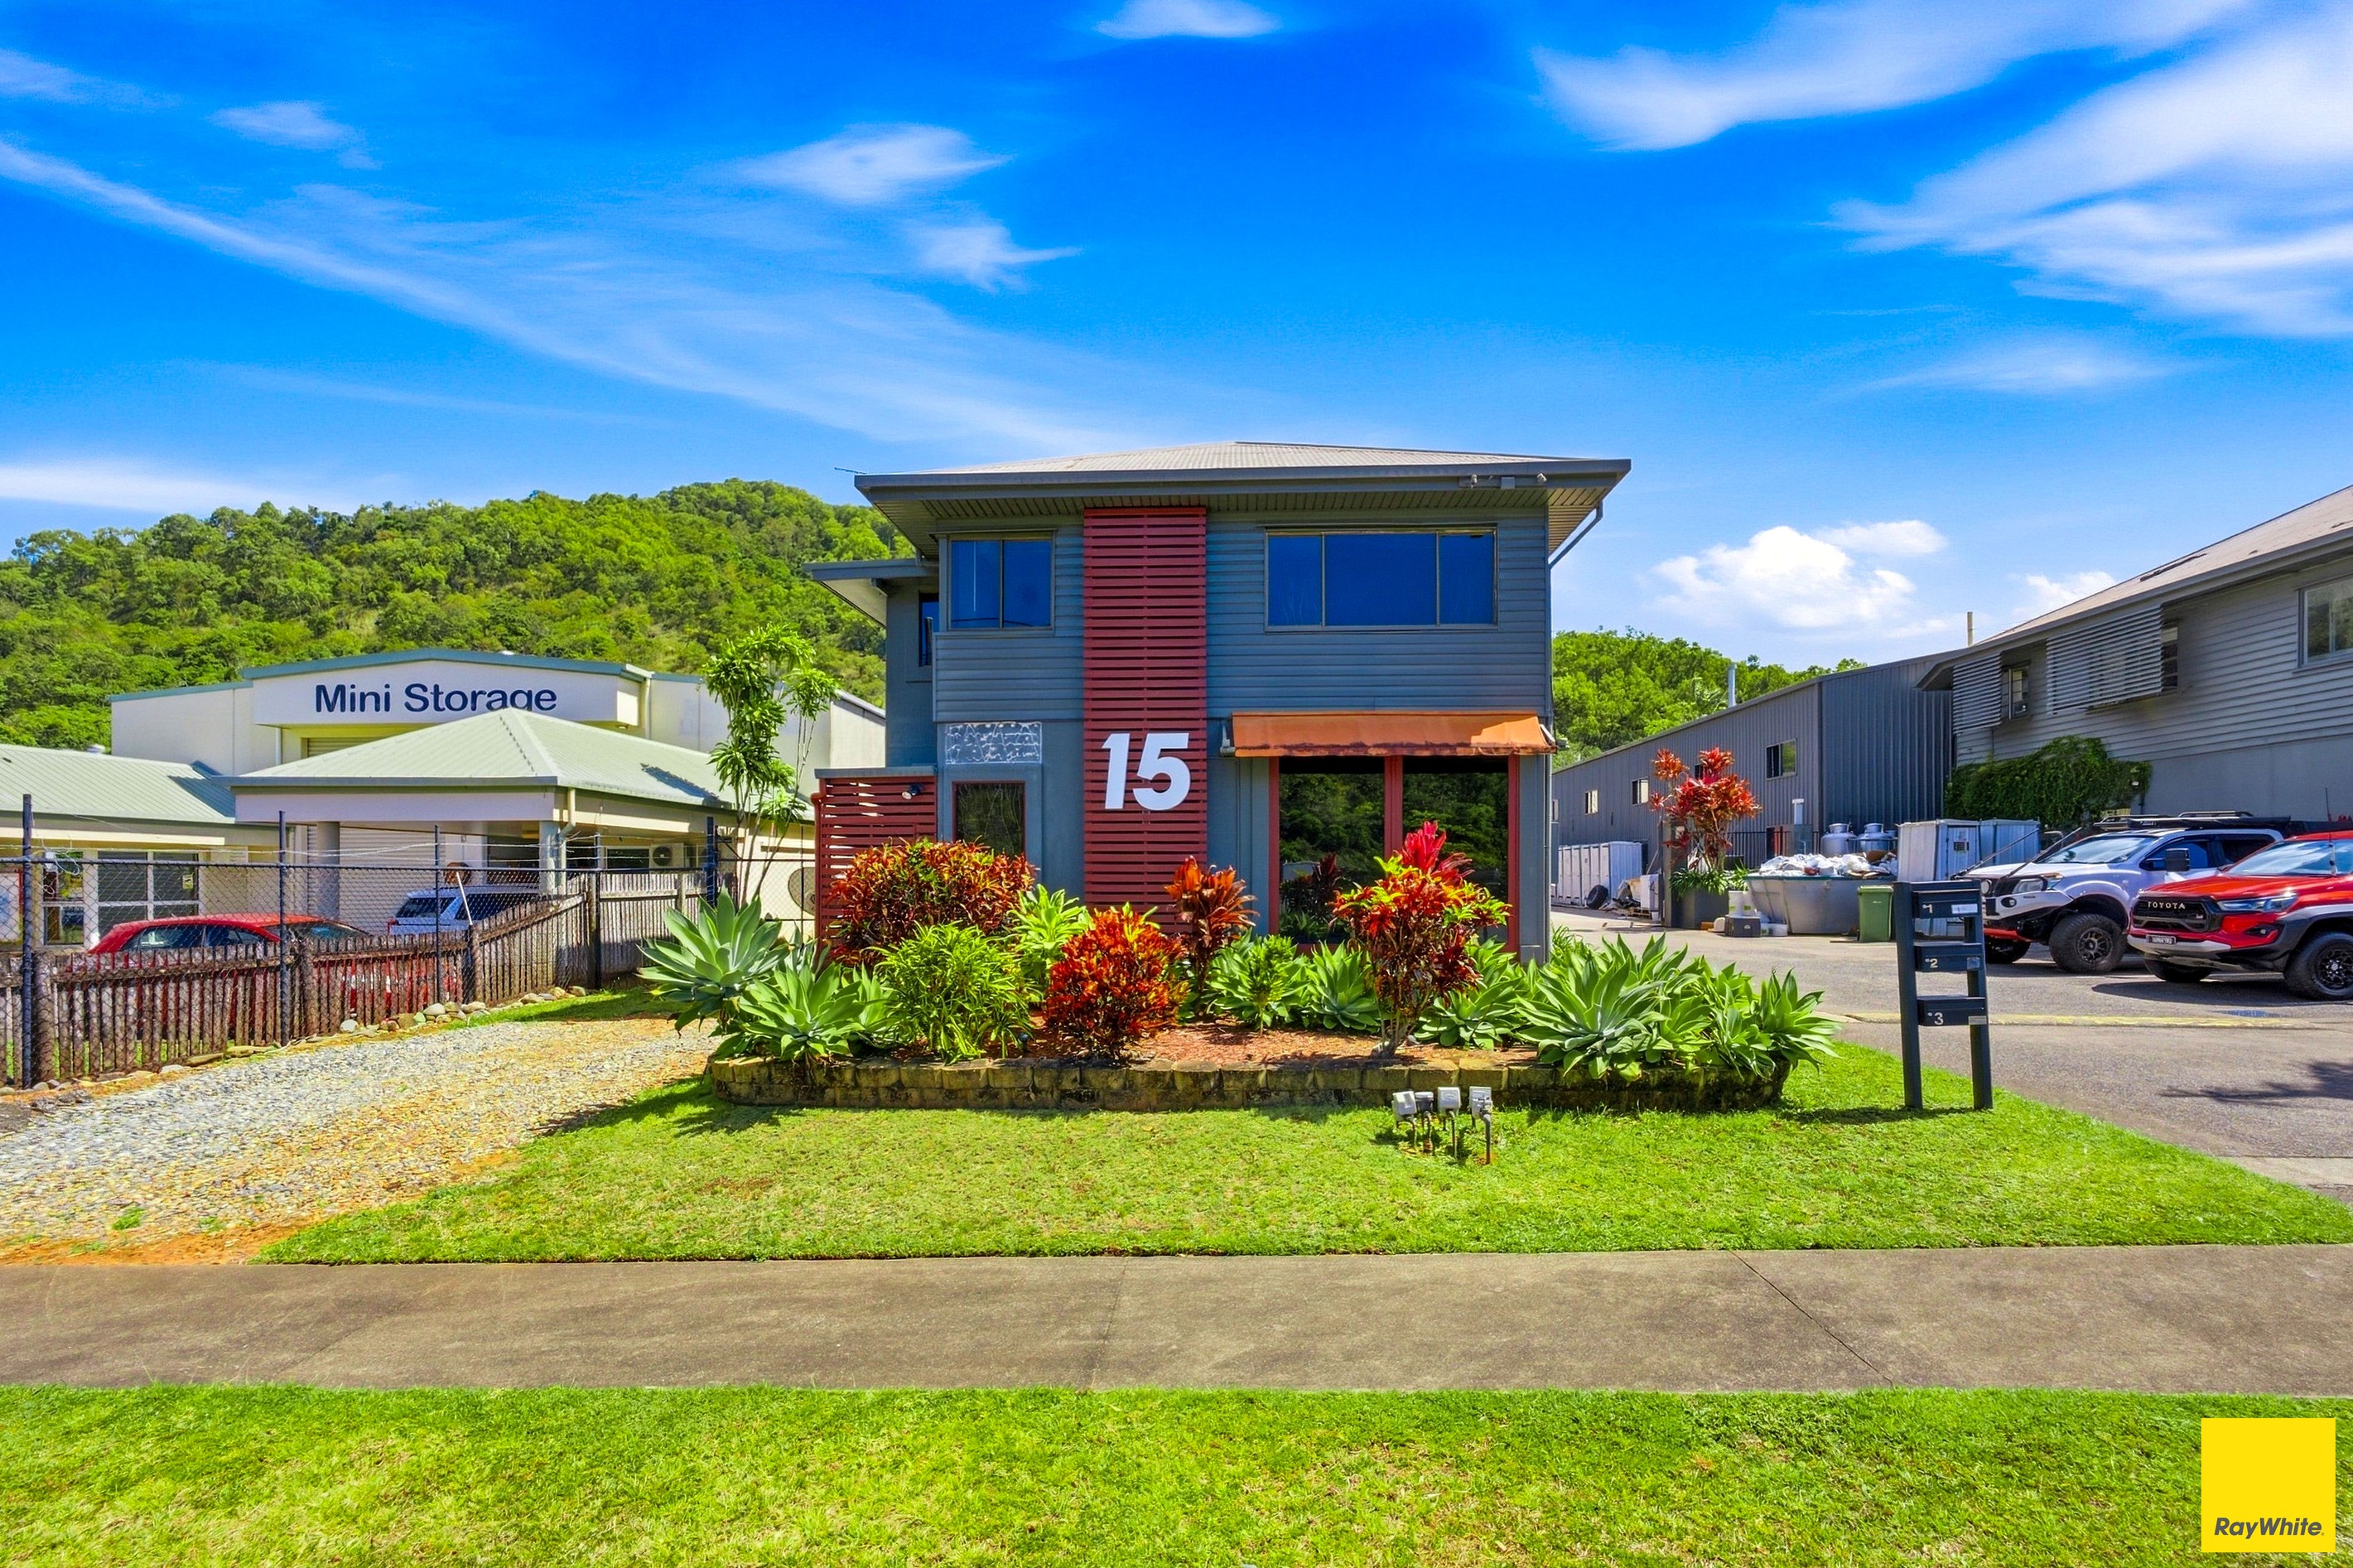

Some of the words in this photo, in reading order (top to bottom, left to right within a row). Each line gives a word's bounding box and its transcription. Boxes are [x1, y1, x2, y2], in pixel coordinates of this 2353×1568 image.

[316, 683, 391, 712] Mini
[404, 683, 557, 712] Storage
[1102, 732, 1191, 811] 15
[2148, 901, 2186, 909] TOYOTA
[1930, 958, 1938, 968] 2
[1934, 1011, 1944, 1025] 3
